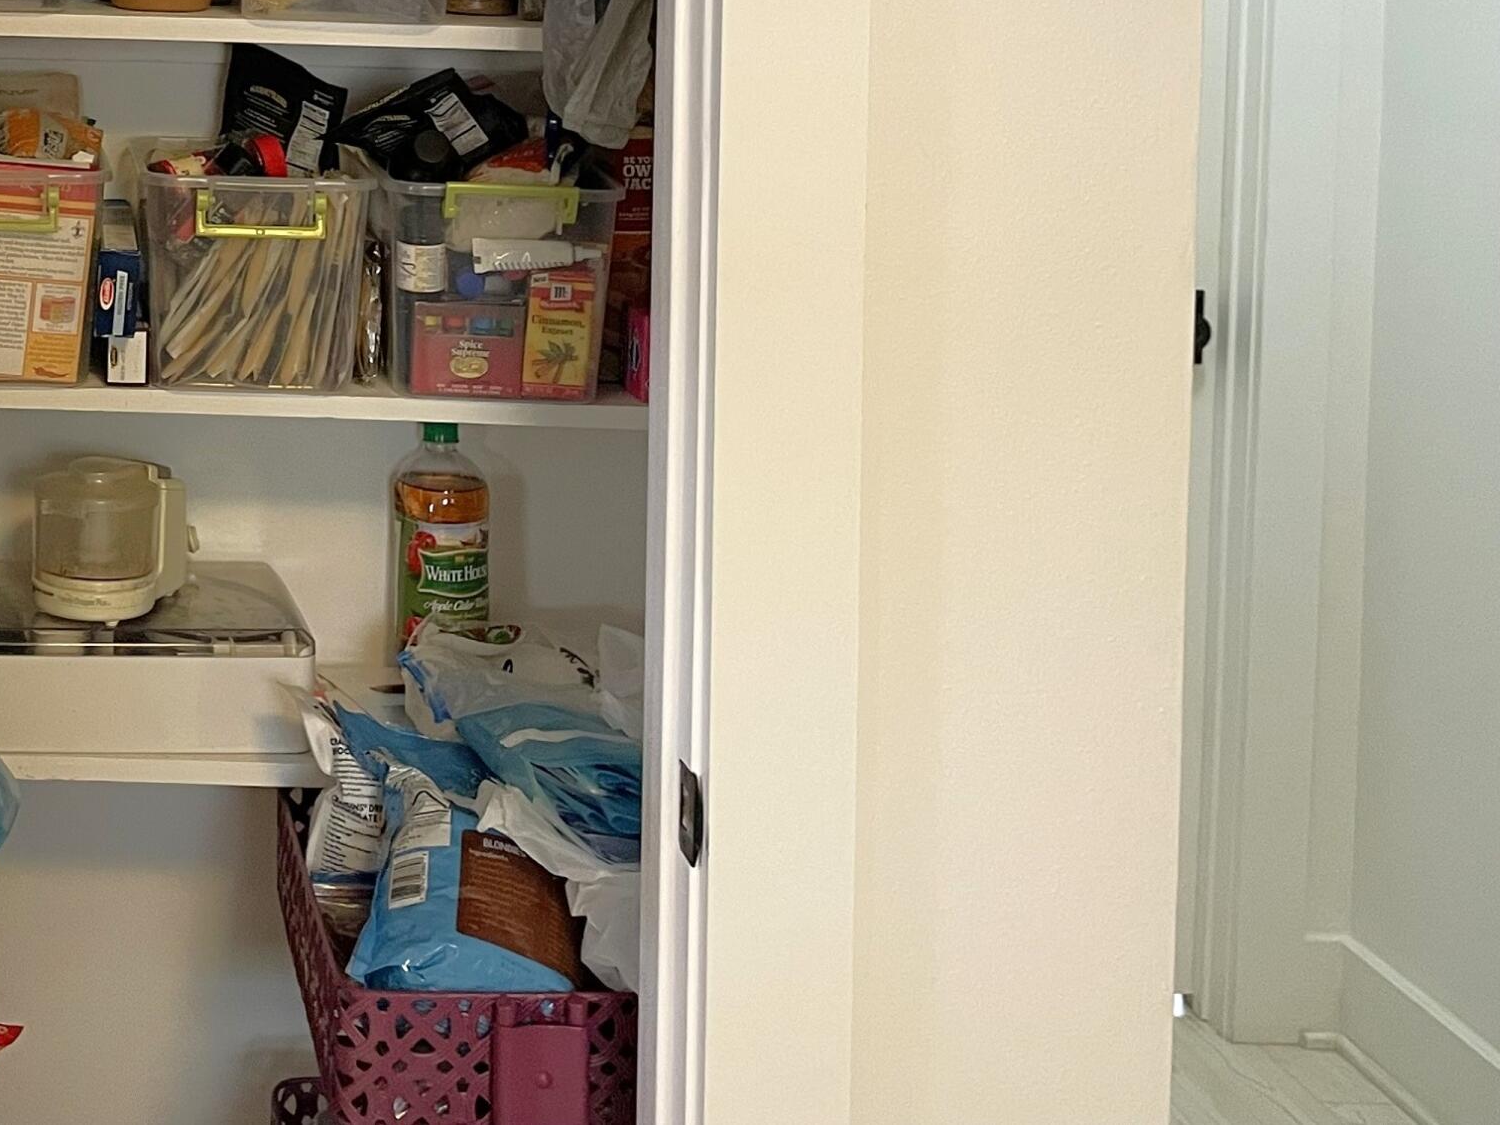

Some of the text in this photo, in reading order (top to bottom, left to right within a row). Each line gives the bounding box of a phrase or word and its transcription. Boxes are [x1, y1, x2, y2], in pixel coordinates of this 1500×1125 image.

[637, 156, 651, 164] YO
[622, 164, 652, 176] OW
[624, 178, 652, 191] JAC
[458, 339, 484, 350] Spice
[451, 348, 491, 359] Supreme
[425, 564, 464, 583] WHITE
[423, 599, 476, 614] Apple Cider
